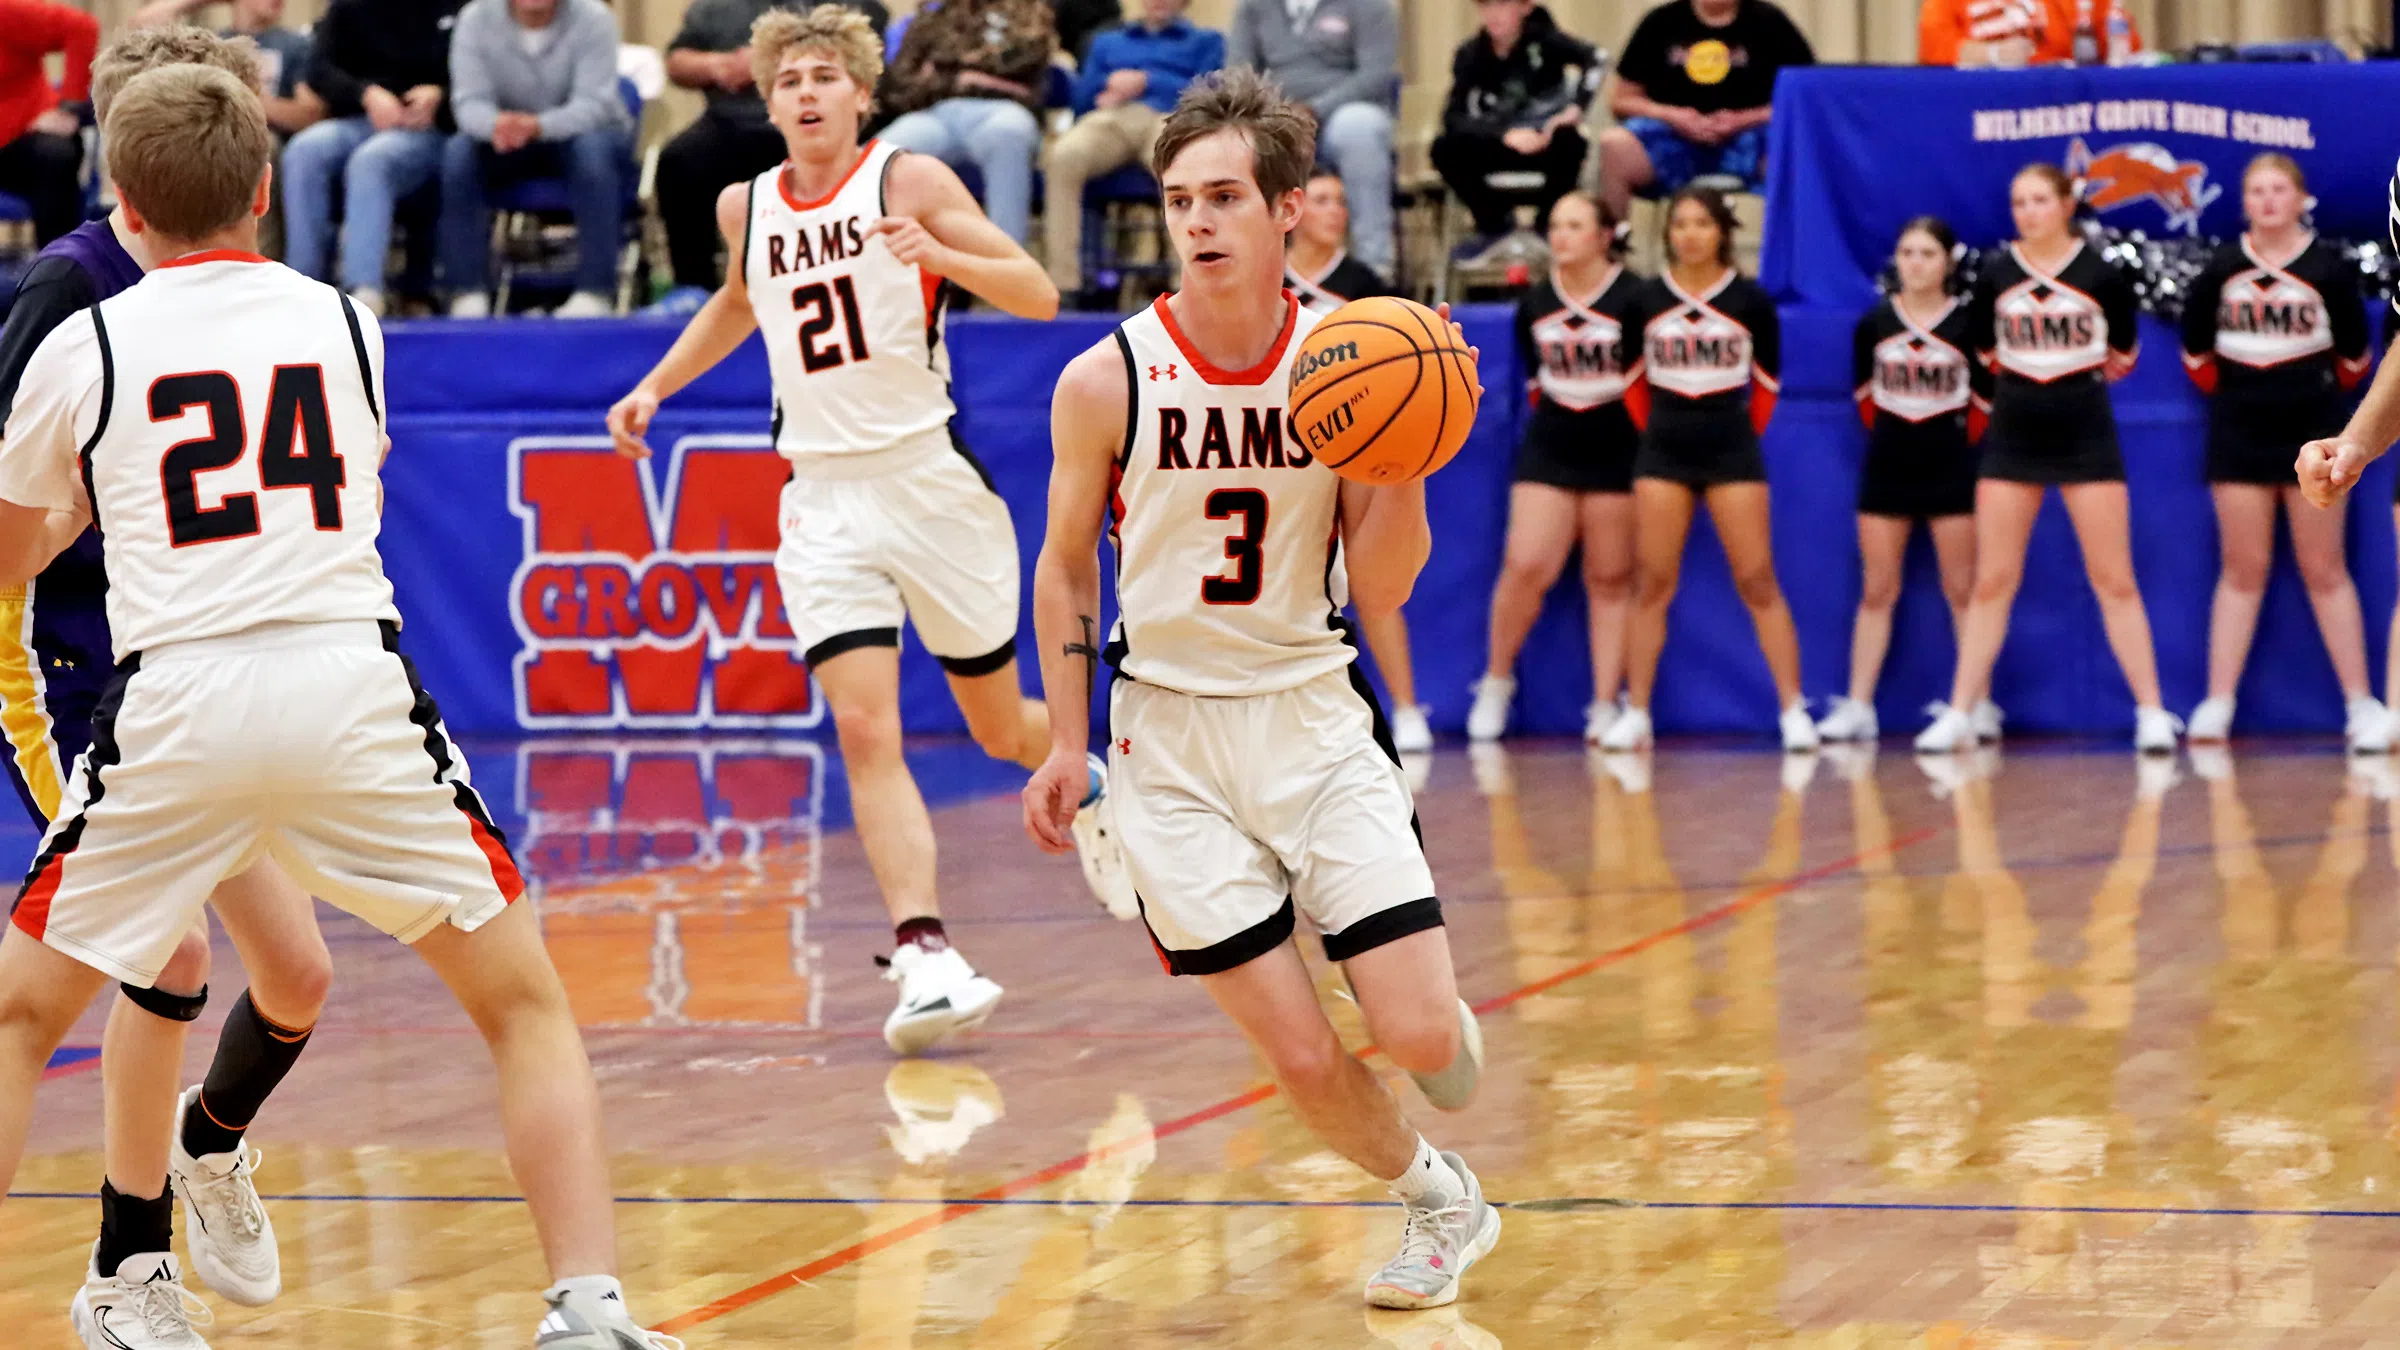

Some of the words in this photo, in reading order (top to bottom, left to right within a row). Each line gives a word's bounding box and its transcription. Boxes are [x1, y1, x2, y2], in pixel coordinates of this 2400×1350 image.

[2096, 100, 2169, 131] GROVE
[2172, 103, 2228, 138] HIGH
[2231, 110, 2315, 149] SCHOOL
[768, 215, 864, 279] RAMS
[791, 274, 871, 374] 21
[147, 363, 347, 549] 24
[1156, 407, 1313, 469] RAMS
[1307, 401, 1355, 451] EVO
[1201, 487, 1269, 605] 3
